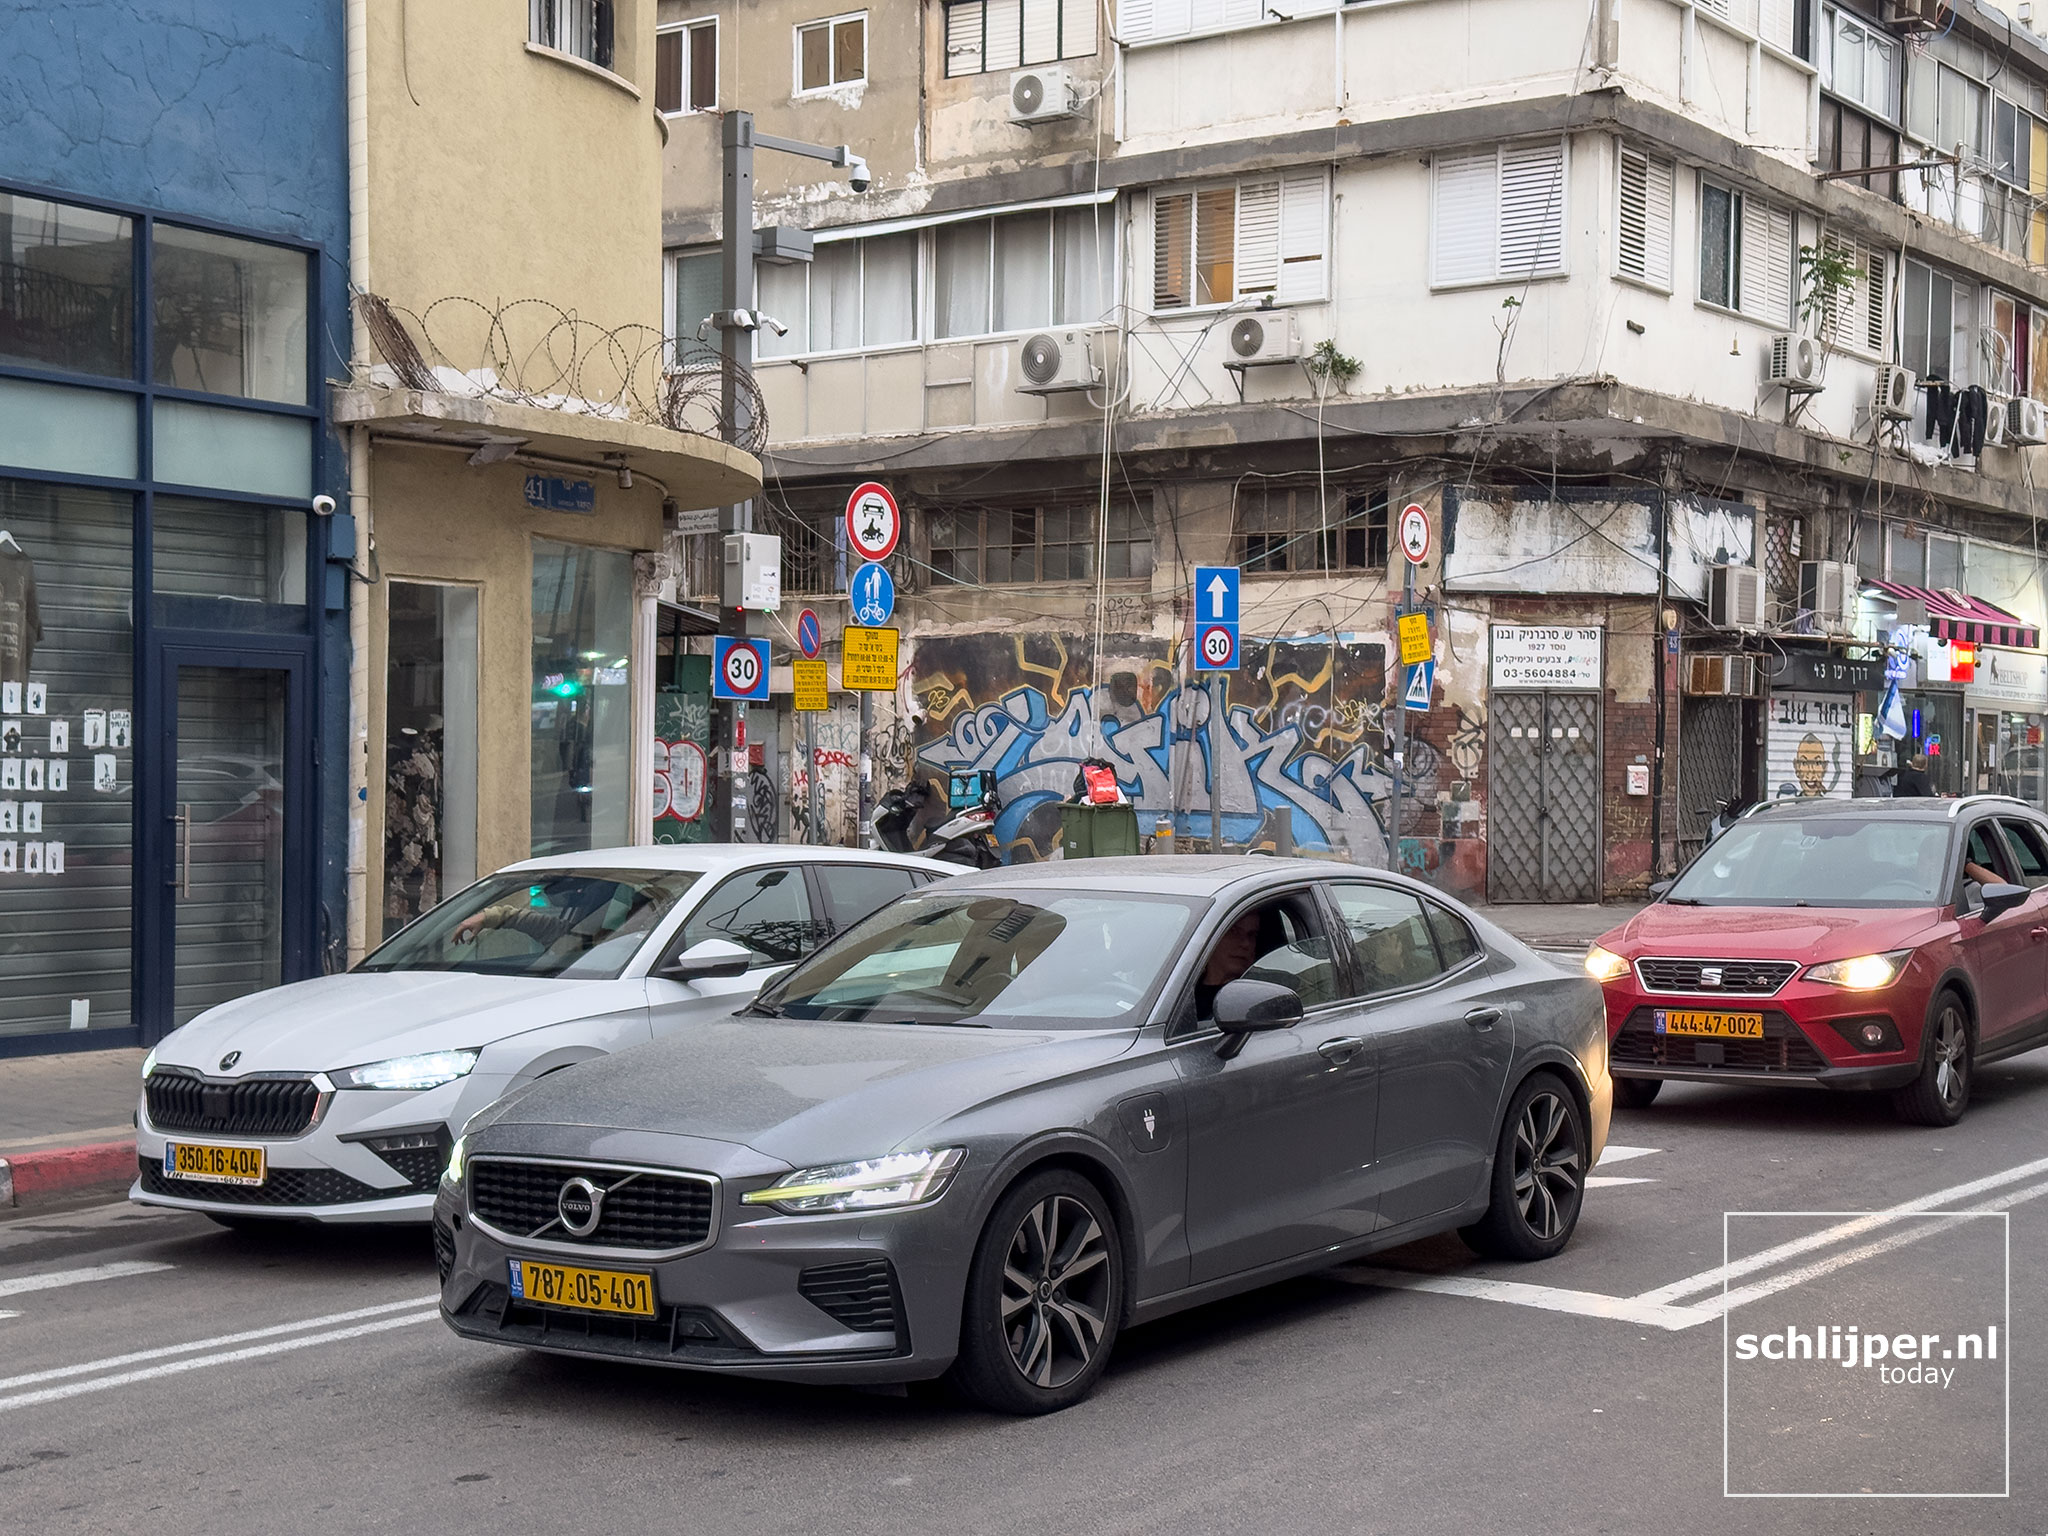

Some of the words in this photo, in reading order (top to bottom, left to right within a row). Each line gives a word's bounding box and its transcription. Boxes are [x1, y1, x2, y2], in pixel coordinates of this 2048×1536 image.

[524, 479, 544, 500] 41
[1496, 629, 1514, 640] ובנו
[1519, 629, 1559, 642] סרברניק
[1577, 629, 1597, 640] סהר
[1208, 638, 1228, 655] 30
[1528, 643, 1545, 651] 1927
[1550, 643, 1566, 651] נוסד
[1495, 654, 1534, 665] וכימיקלים
[1536, 655, 1562, 664] צבעים
[731, 657, 754, 680] 30
[1503, 668, 1577, 678] 03-5604884
[1813, 663, 1826, 678] 43
[1833, 664, 1847, 680] יפו
[1850, 667, 1868, 685] דרך
[1814, 701, 1852, 728] בחור
[562, 1202, 591, 1213] VOLVO
